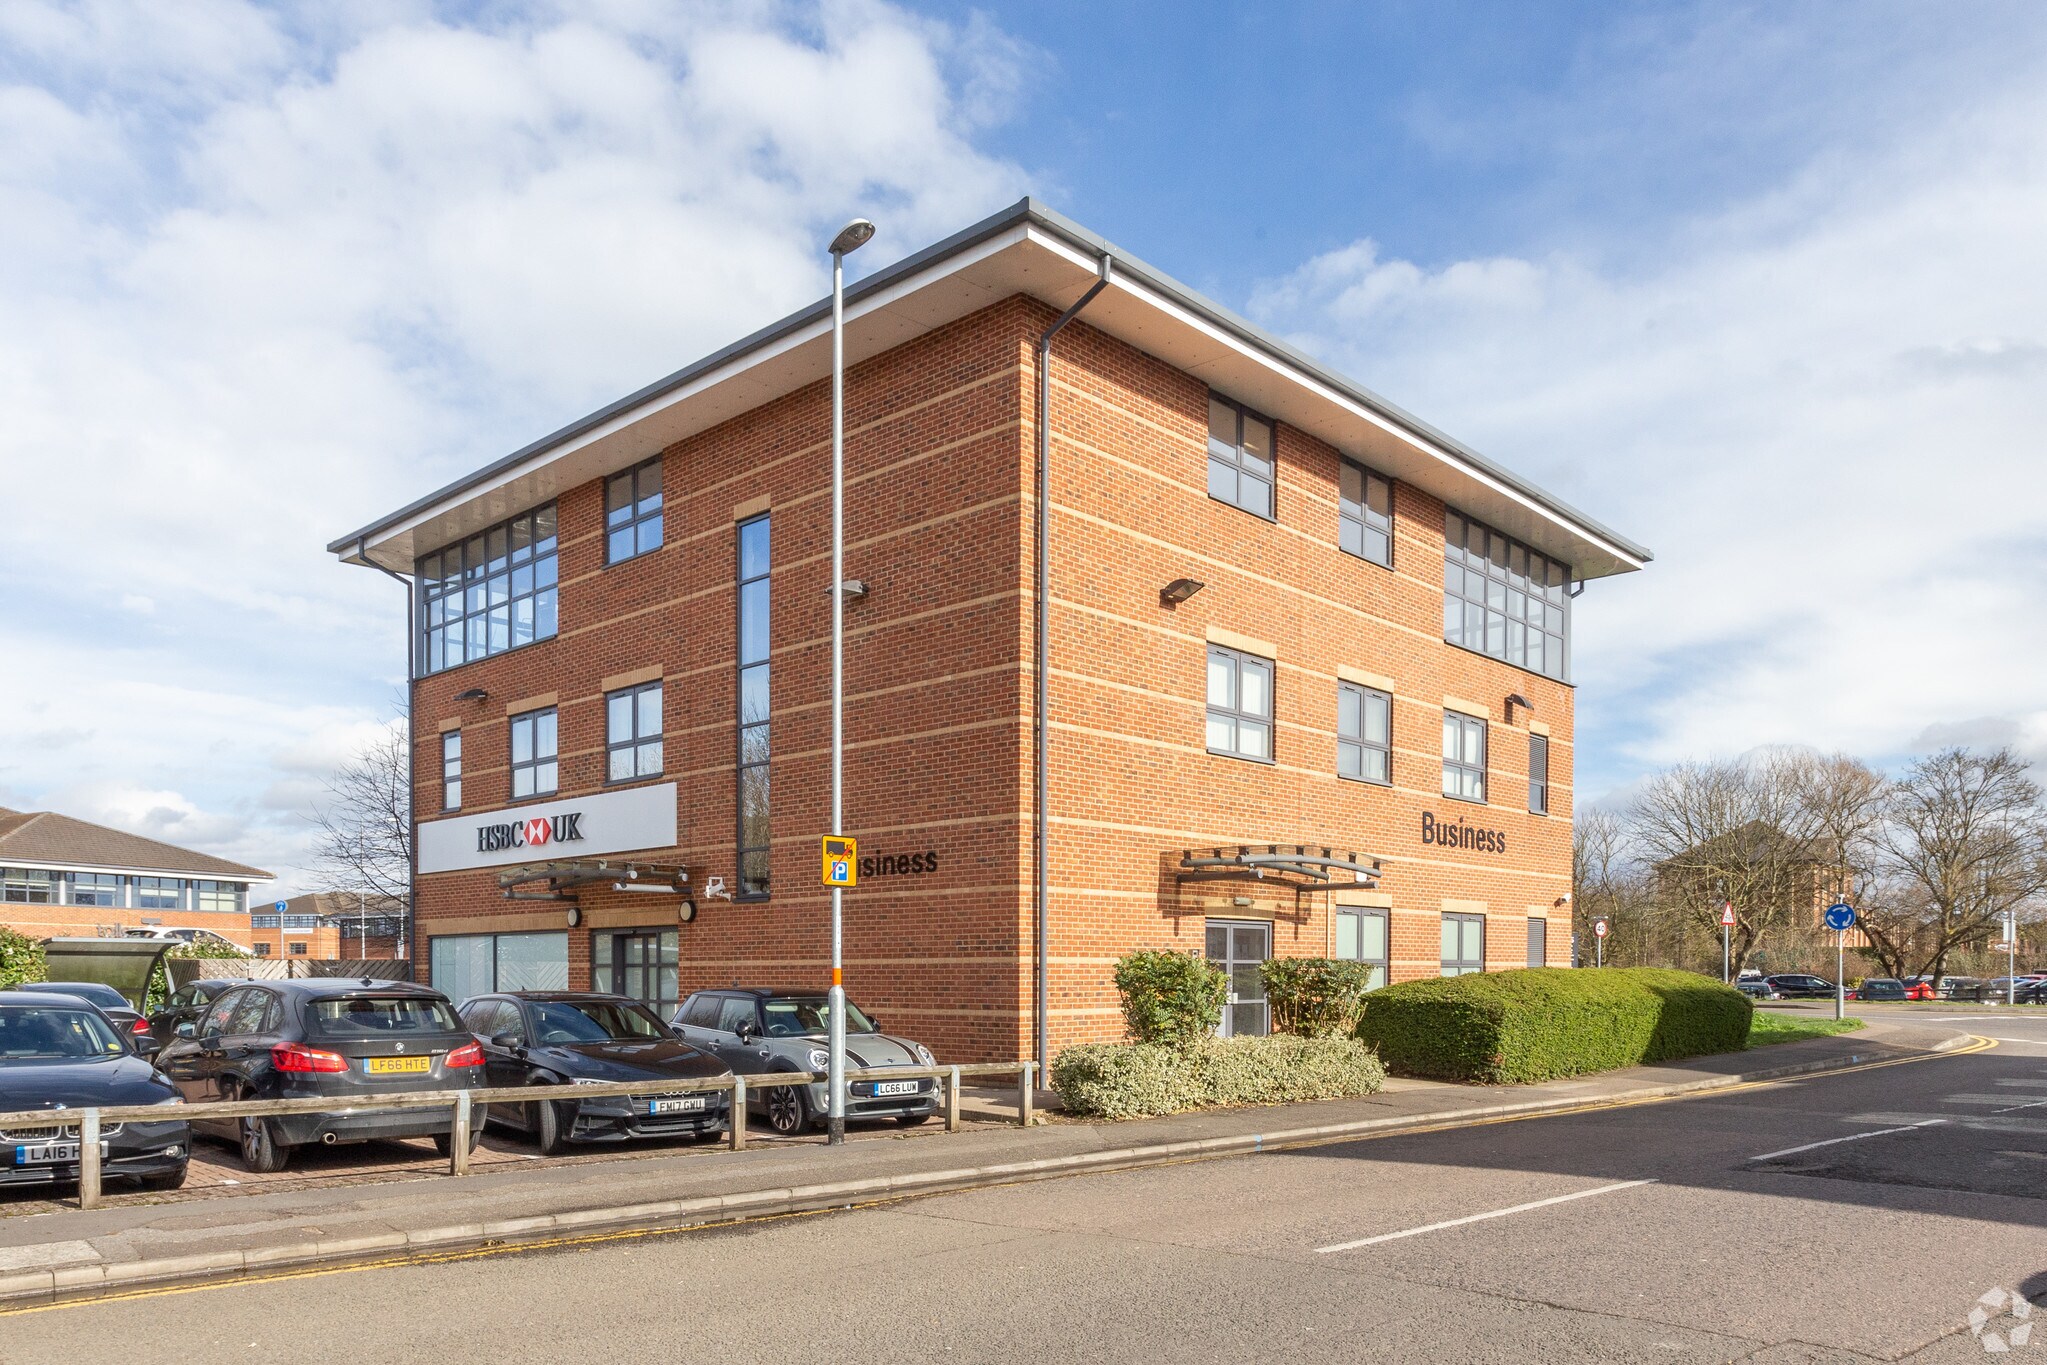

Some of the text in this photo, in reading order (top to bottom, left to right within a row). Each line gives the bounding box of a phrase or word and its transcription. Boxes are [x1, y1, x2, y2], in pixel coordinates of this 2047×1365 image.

[477, 812, 584, 852] HSBC UK
[1422, 811, 1505, 853] Business
[835, 862, 846, 879] P
[857, 849, 938, 877] siness
[371, 1058, 427, 1071] LF66 HTE
[880, 1084, 900, 1094] LC66
[31, 1146, 67, 1160] LA16
